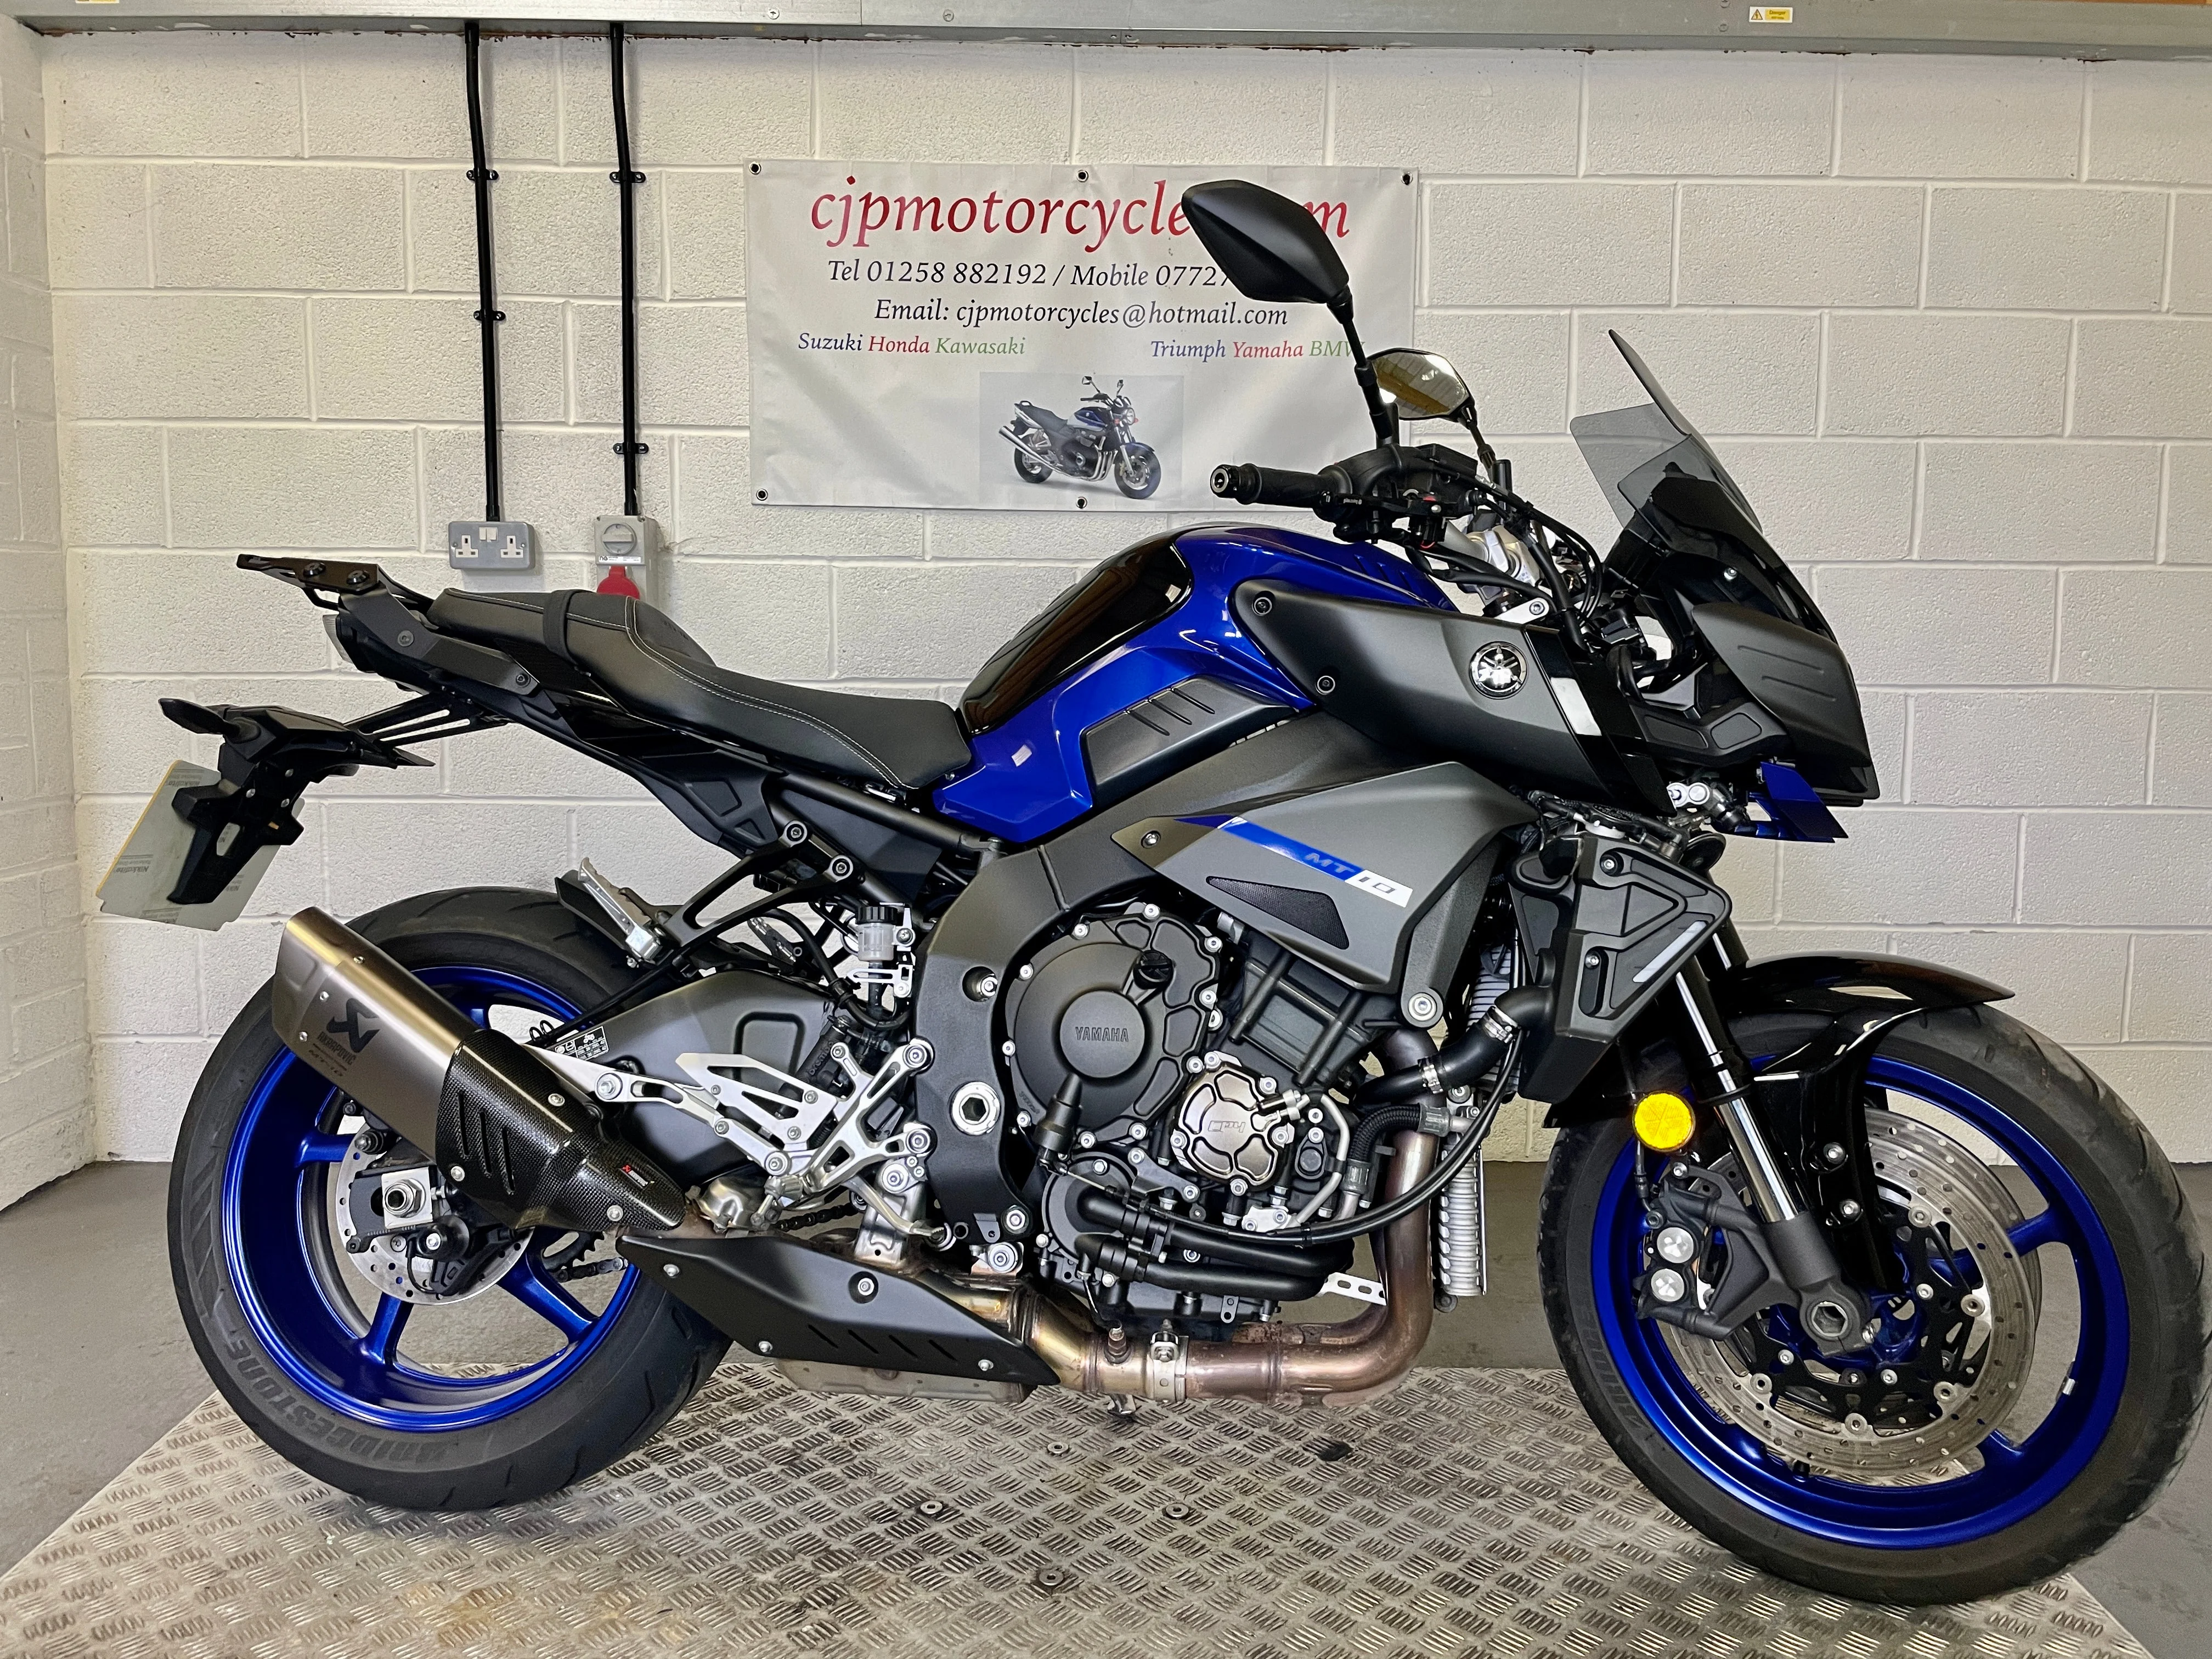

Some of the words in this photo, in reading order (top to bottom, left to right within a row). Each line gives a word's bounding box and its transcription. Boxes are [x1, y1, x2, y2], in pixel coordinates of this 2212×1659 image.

[811, 175, 1350, 252] cjpmotorcyclem
[828, 258, 860, 281] Tel
[867, 260, 946, 283] 01258
[953, 262, 1047, 285] 882192
[1052, 264, 1066, 287] /
[1070, 263, 1149, 287] Mobile
[874, 298, 949, 321] Email:
[956, 298, 1288, 329] cjpmotorcycles@hotmail.com
[798, 332, 864, 352] Suzuki
[868, 335, 930, 353] Honda
[935, 336, 1026, 355] Kawasaki
[1150, 339, 1226, 363] Triumph
[1233, 340, 1304, 359] Yamaha
[1304, 853, 1357, 874] MT
[1075, 1026, 1129, 1042] YAMAHA
[806, 1040, 834, 1076] brembo
